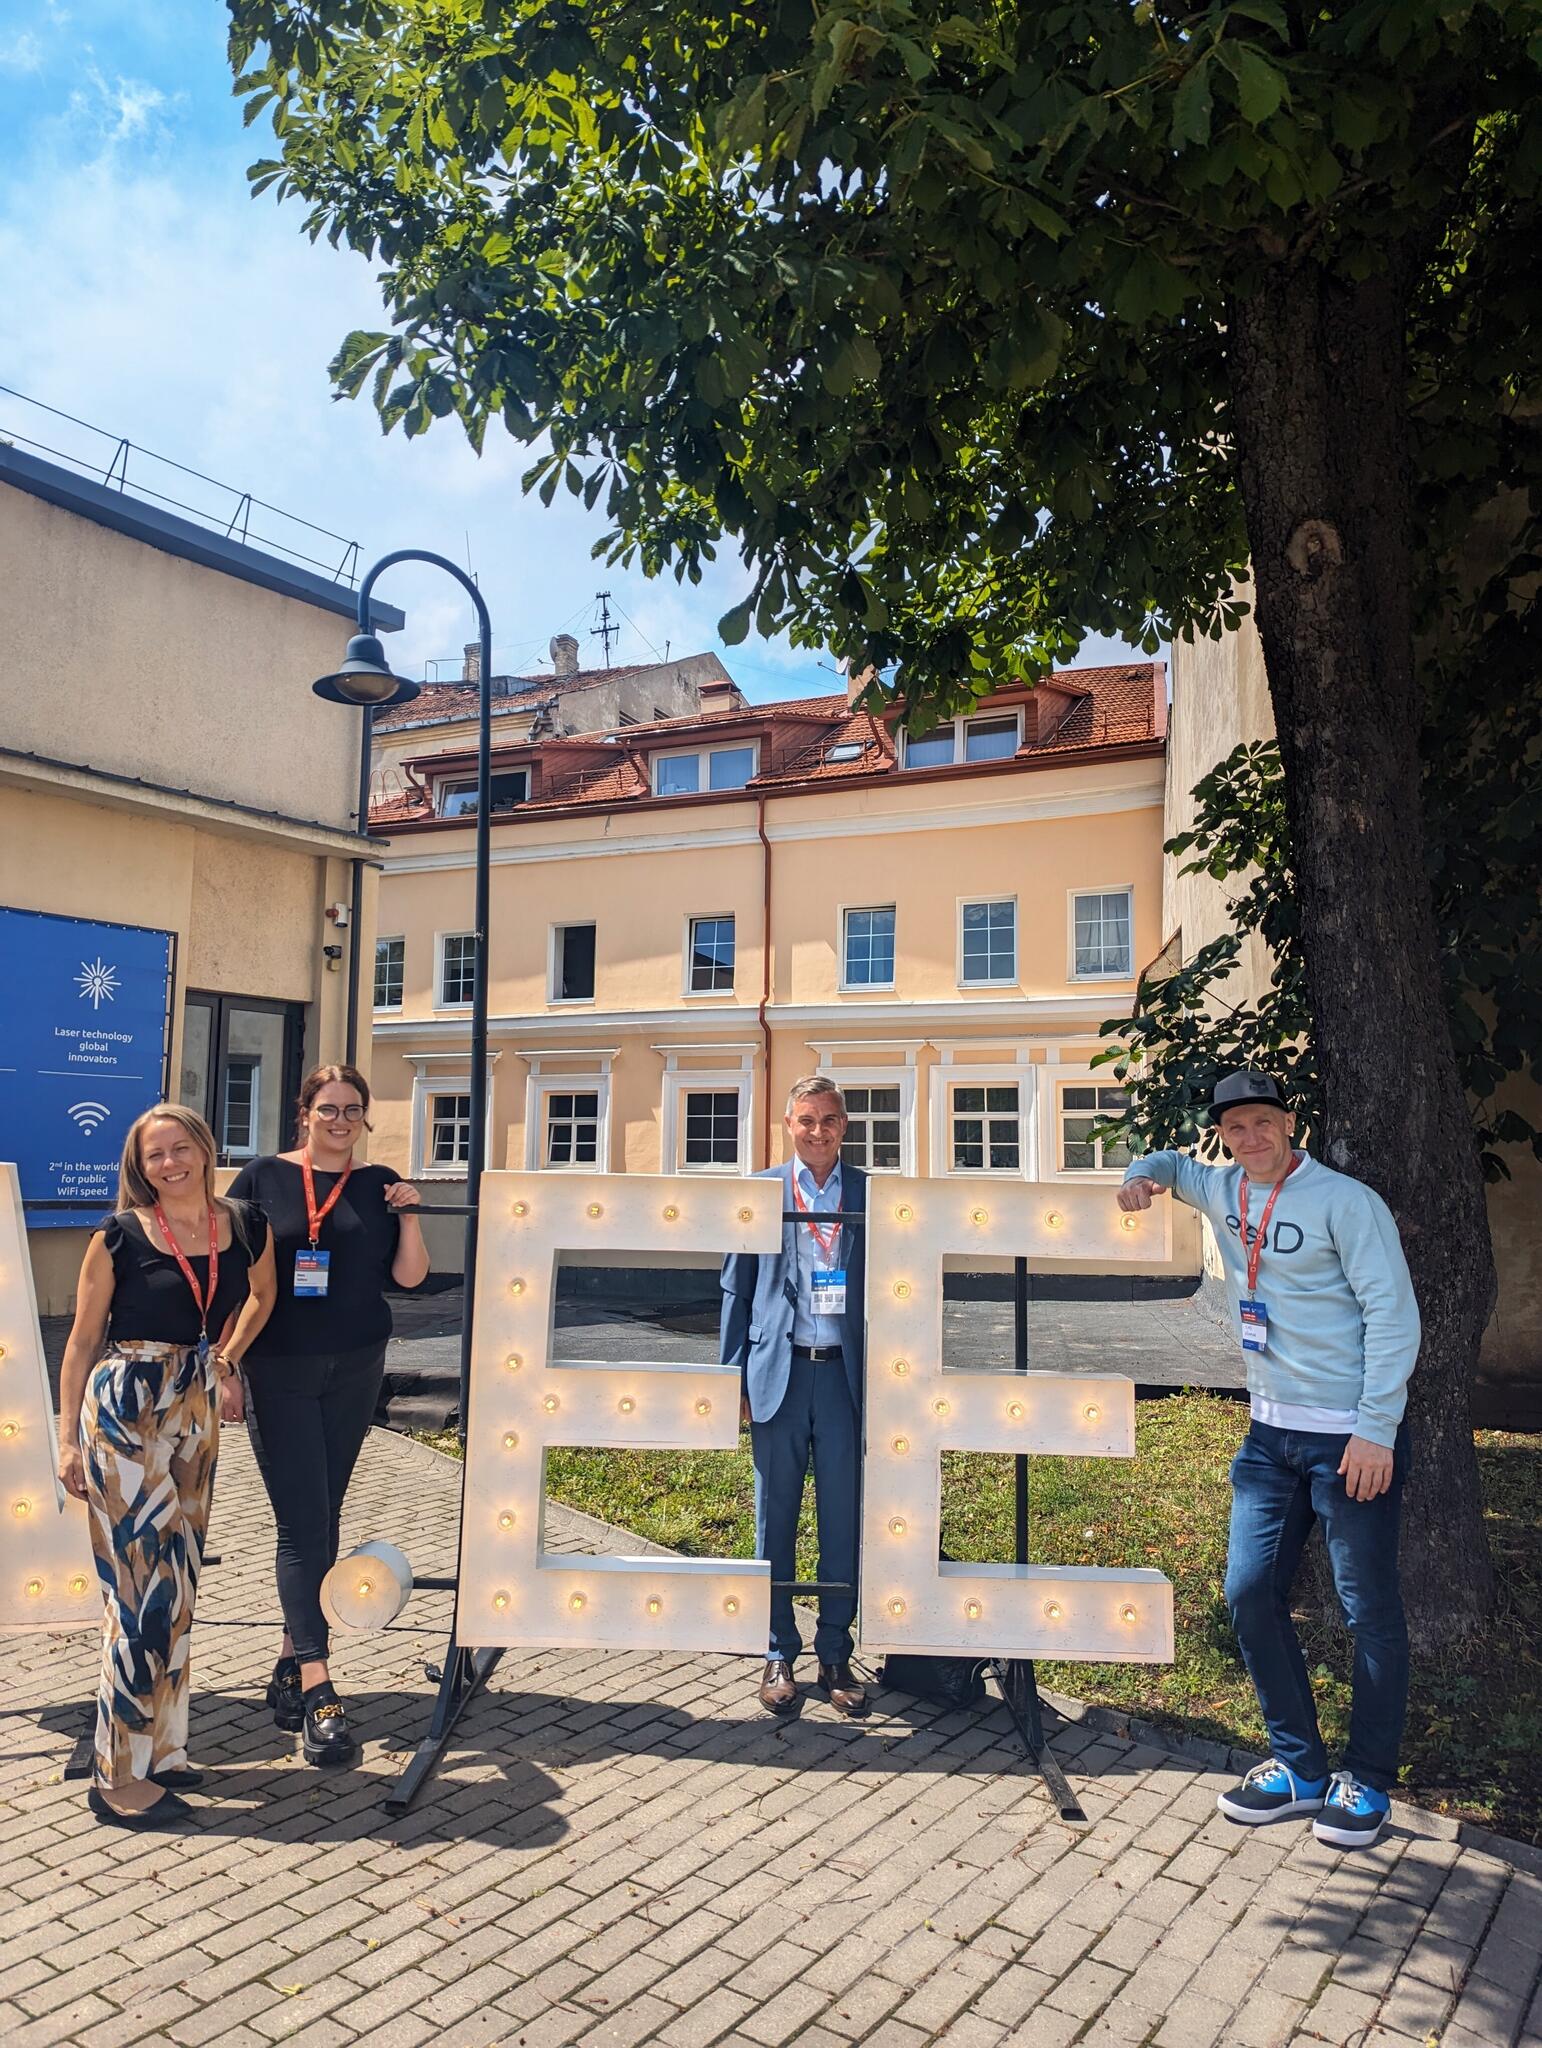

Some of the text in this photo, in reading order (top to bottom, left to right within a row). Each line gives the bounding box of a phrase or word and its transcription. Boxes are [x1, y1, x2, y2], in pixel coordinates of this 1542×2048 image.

[54, 1026, 133, 1044] Laser technology
[79, 1041, 109, 1053] global
[68, 1053, 118, 1065] innovators
[64, 1162, 74, 1172] in
[75, 1162, 92, 1172] the
[93, 1161, 120, 1172] world
[61, 1174, 107, 1187] for public
[57, 1186, 108, 1199] WiFi speed
